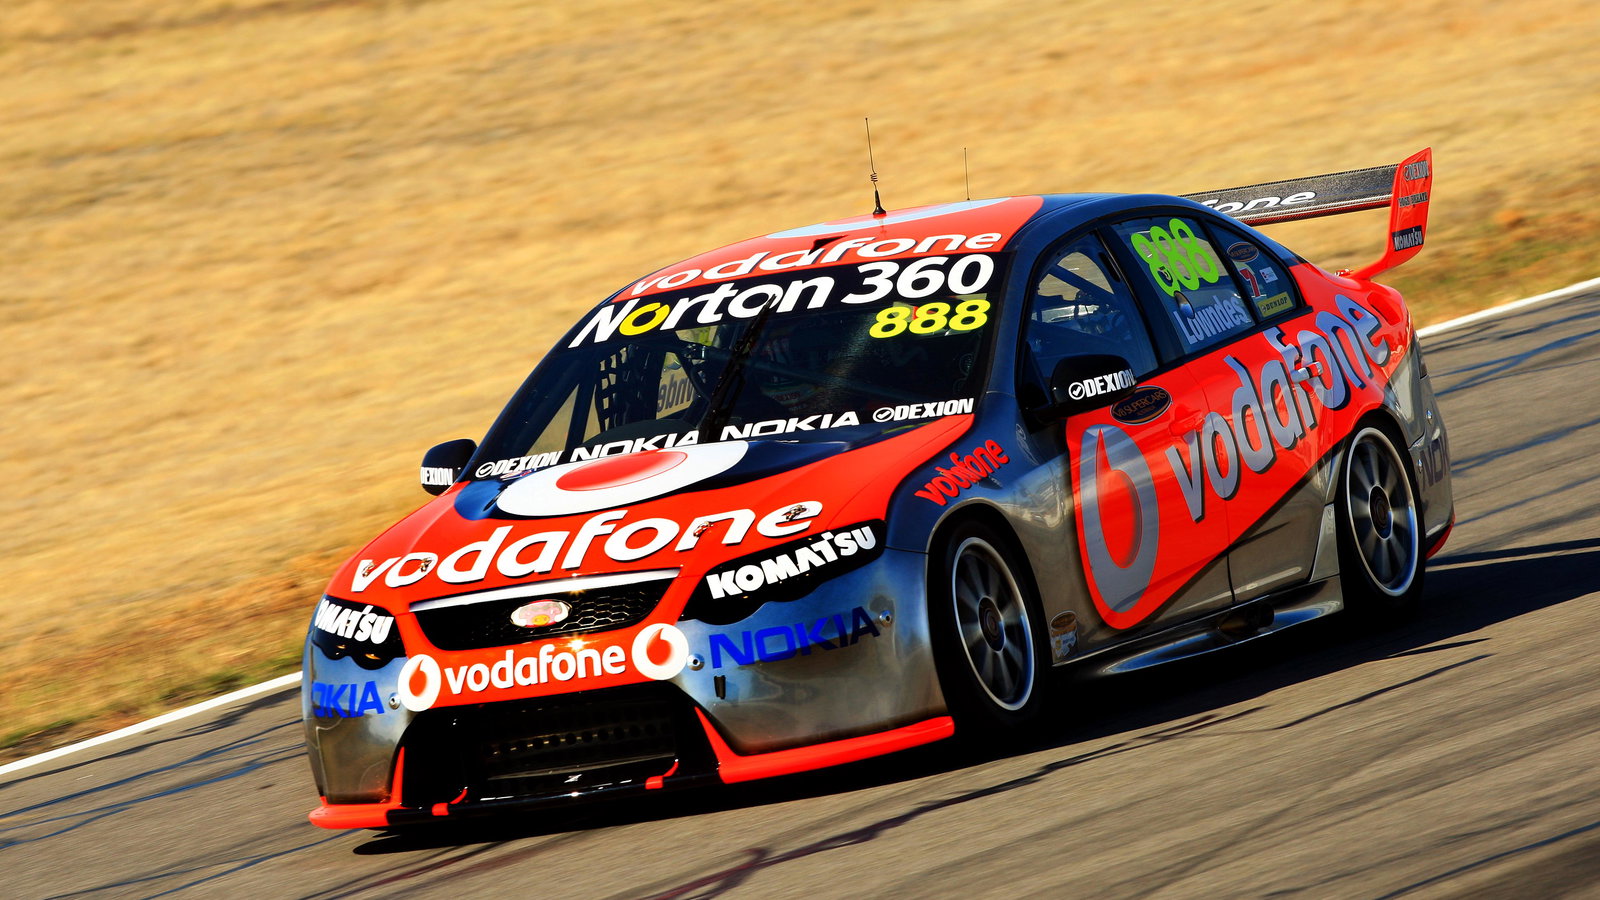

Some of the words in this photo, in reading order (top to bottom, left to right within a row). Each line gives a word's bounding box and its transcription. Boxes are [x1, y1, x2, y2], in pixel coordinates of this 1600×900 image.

[1200, 191, 1317, 213] fone
[1130, 218, 1219, 297] 888
[1394, 227, 1422, 251] KOMATSU
[630, 232, 1002, 297] vodafone
[568, 276, 834, 348] Norton
[840, 254, 995, 303] 360
[868, 299, 991, 338] 888
[1173, 295, 1249, 344] Lowndes
[1265, 296, 1288, 311] DUNLOP
[1082, 368, 1138, 398] DEXION
[1165, 294, 1392, 523] vodafone
[491, 450, 565, 476] DEXION
[570, 430, 700, 462] NOKIA
[720, 410, 860, 442] NOKIA
[894, 398, 975, 421] DEXION
[420, 466, 453, 486] DEXION
[914, 439, 1009, 507] vodafone
[350, 500, 823, 593] vodafone
[706, 526, 876, 599] KOMATSU
[314, 598, 394, 645] OMATSU
[709, 606, 880, 669] NOKIA
[445, 645, 627, 694] vodafone
[311, 681, 385, 718] OKIA
